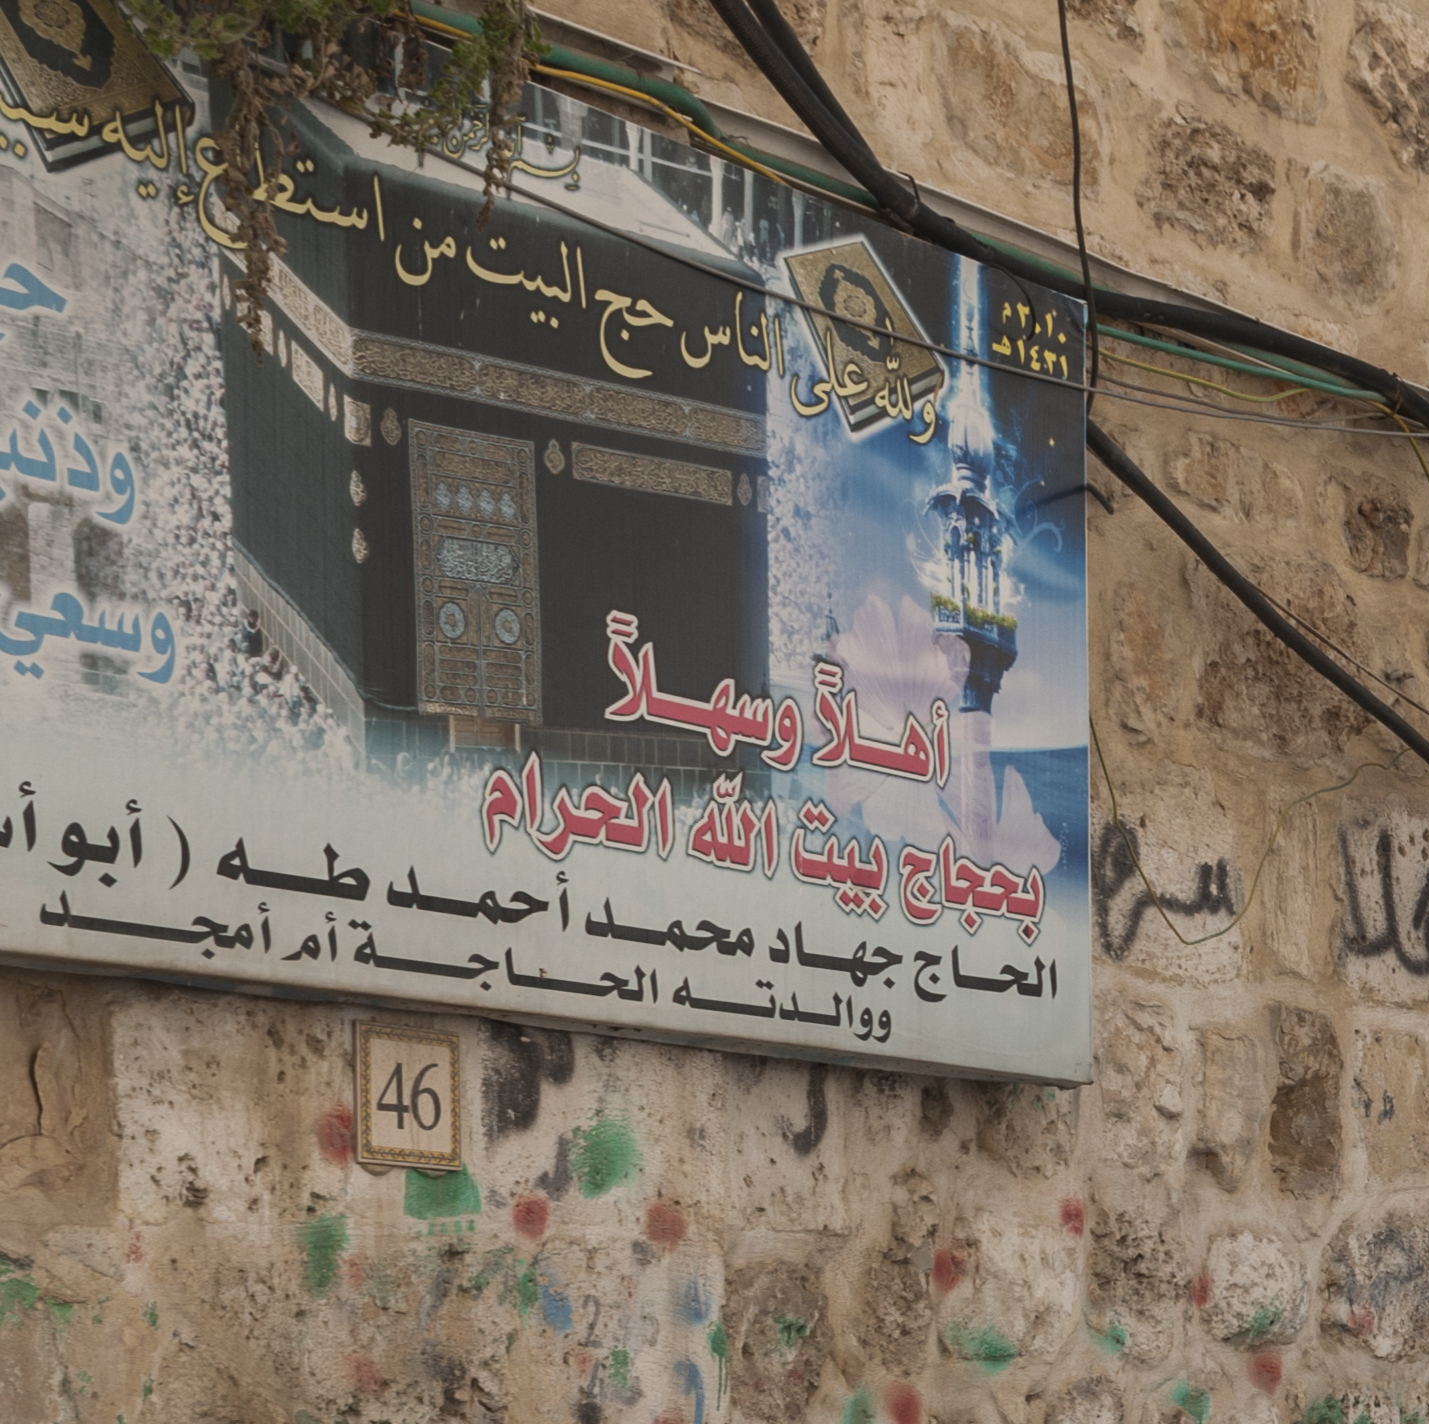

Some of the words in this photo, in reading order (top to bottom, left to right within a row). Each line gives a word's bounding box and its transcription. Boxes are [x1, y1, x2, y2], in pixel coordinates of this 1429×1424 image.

[101, 98, 195, 204] إليه
[195, 135, 386, 250] استطع
[394, 217, 457, 287] من
[465, 236, 587, 329] البيت
[593, 288, 675, 379] حج
[679, 291, 786, 378] الناس
[791, 327, 868, 418] على
[481, 750, 676, 861] الحرام
[688, 770, 779, 880] الله
[215, 835, 372, 902] طه
[385, 870, 571, 934] أحمد
[790, 801, 889, 921] بيت
[899, 835, 1046, 946] بحجاج
[38, 890, 274, 960] أمجد
[279, 910, 340, 963] أم
[351, 917, 660, 1004] الحاجة
[583, 895, 755, 959] محمد
[768, 920, 904, 988] جهاد
[913, 944, 1059, 1003] الحاج
[375, 1061, 443, 1133] 46
